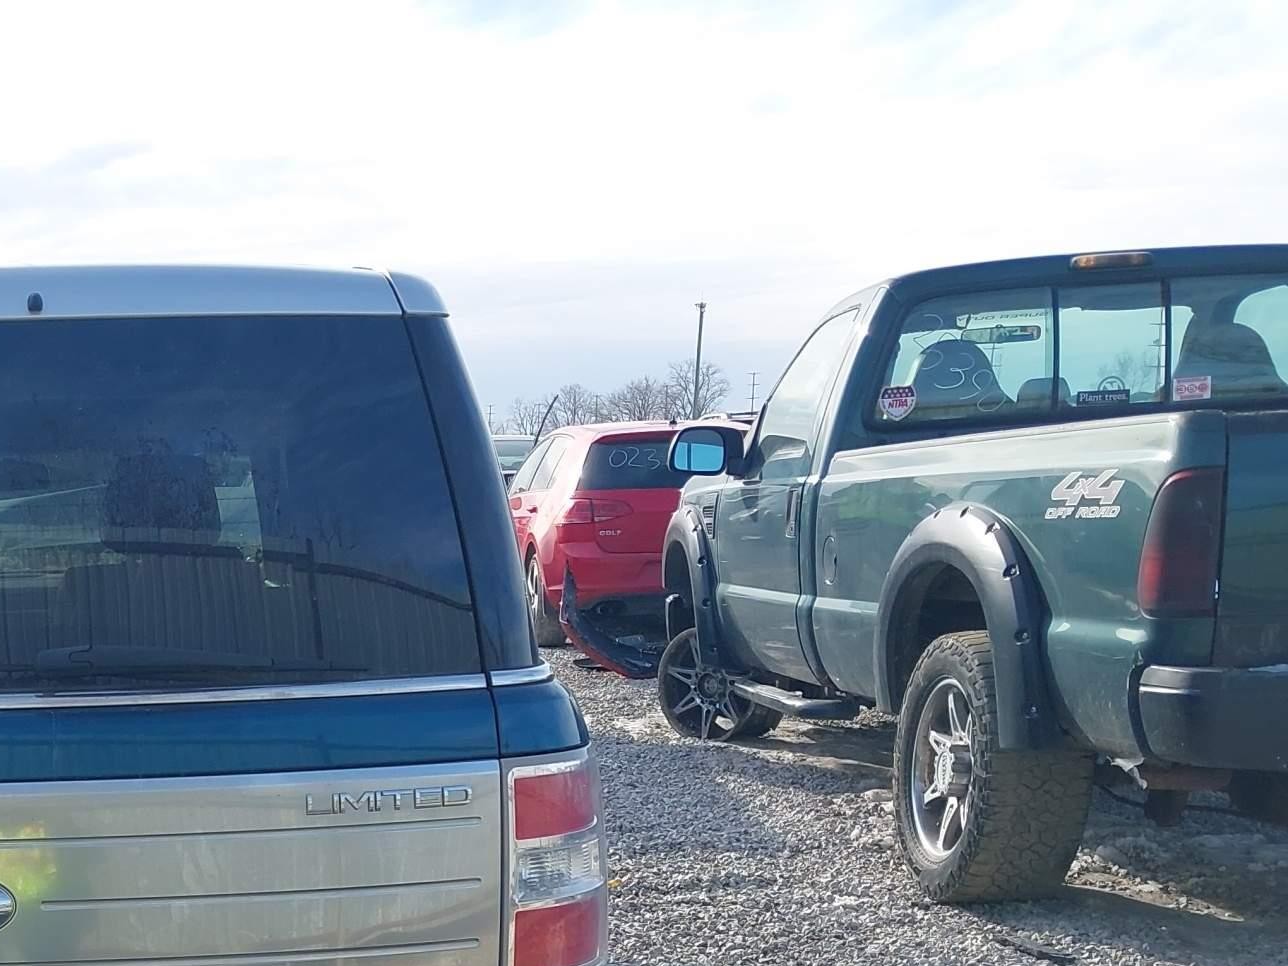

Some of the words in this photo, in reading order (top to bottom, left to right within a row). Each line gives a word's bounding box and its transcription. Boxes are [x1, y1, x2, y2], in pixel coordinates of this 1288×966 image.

[1079, 393, 1103, 402] Plant
[1044, 506, 1075, 519] OFF
[1075, 505, 1121, 519] ROAD
[599, 529, 622, 537] GOLF
[305, 784, 473, 816] LIMITED
